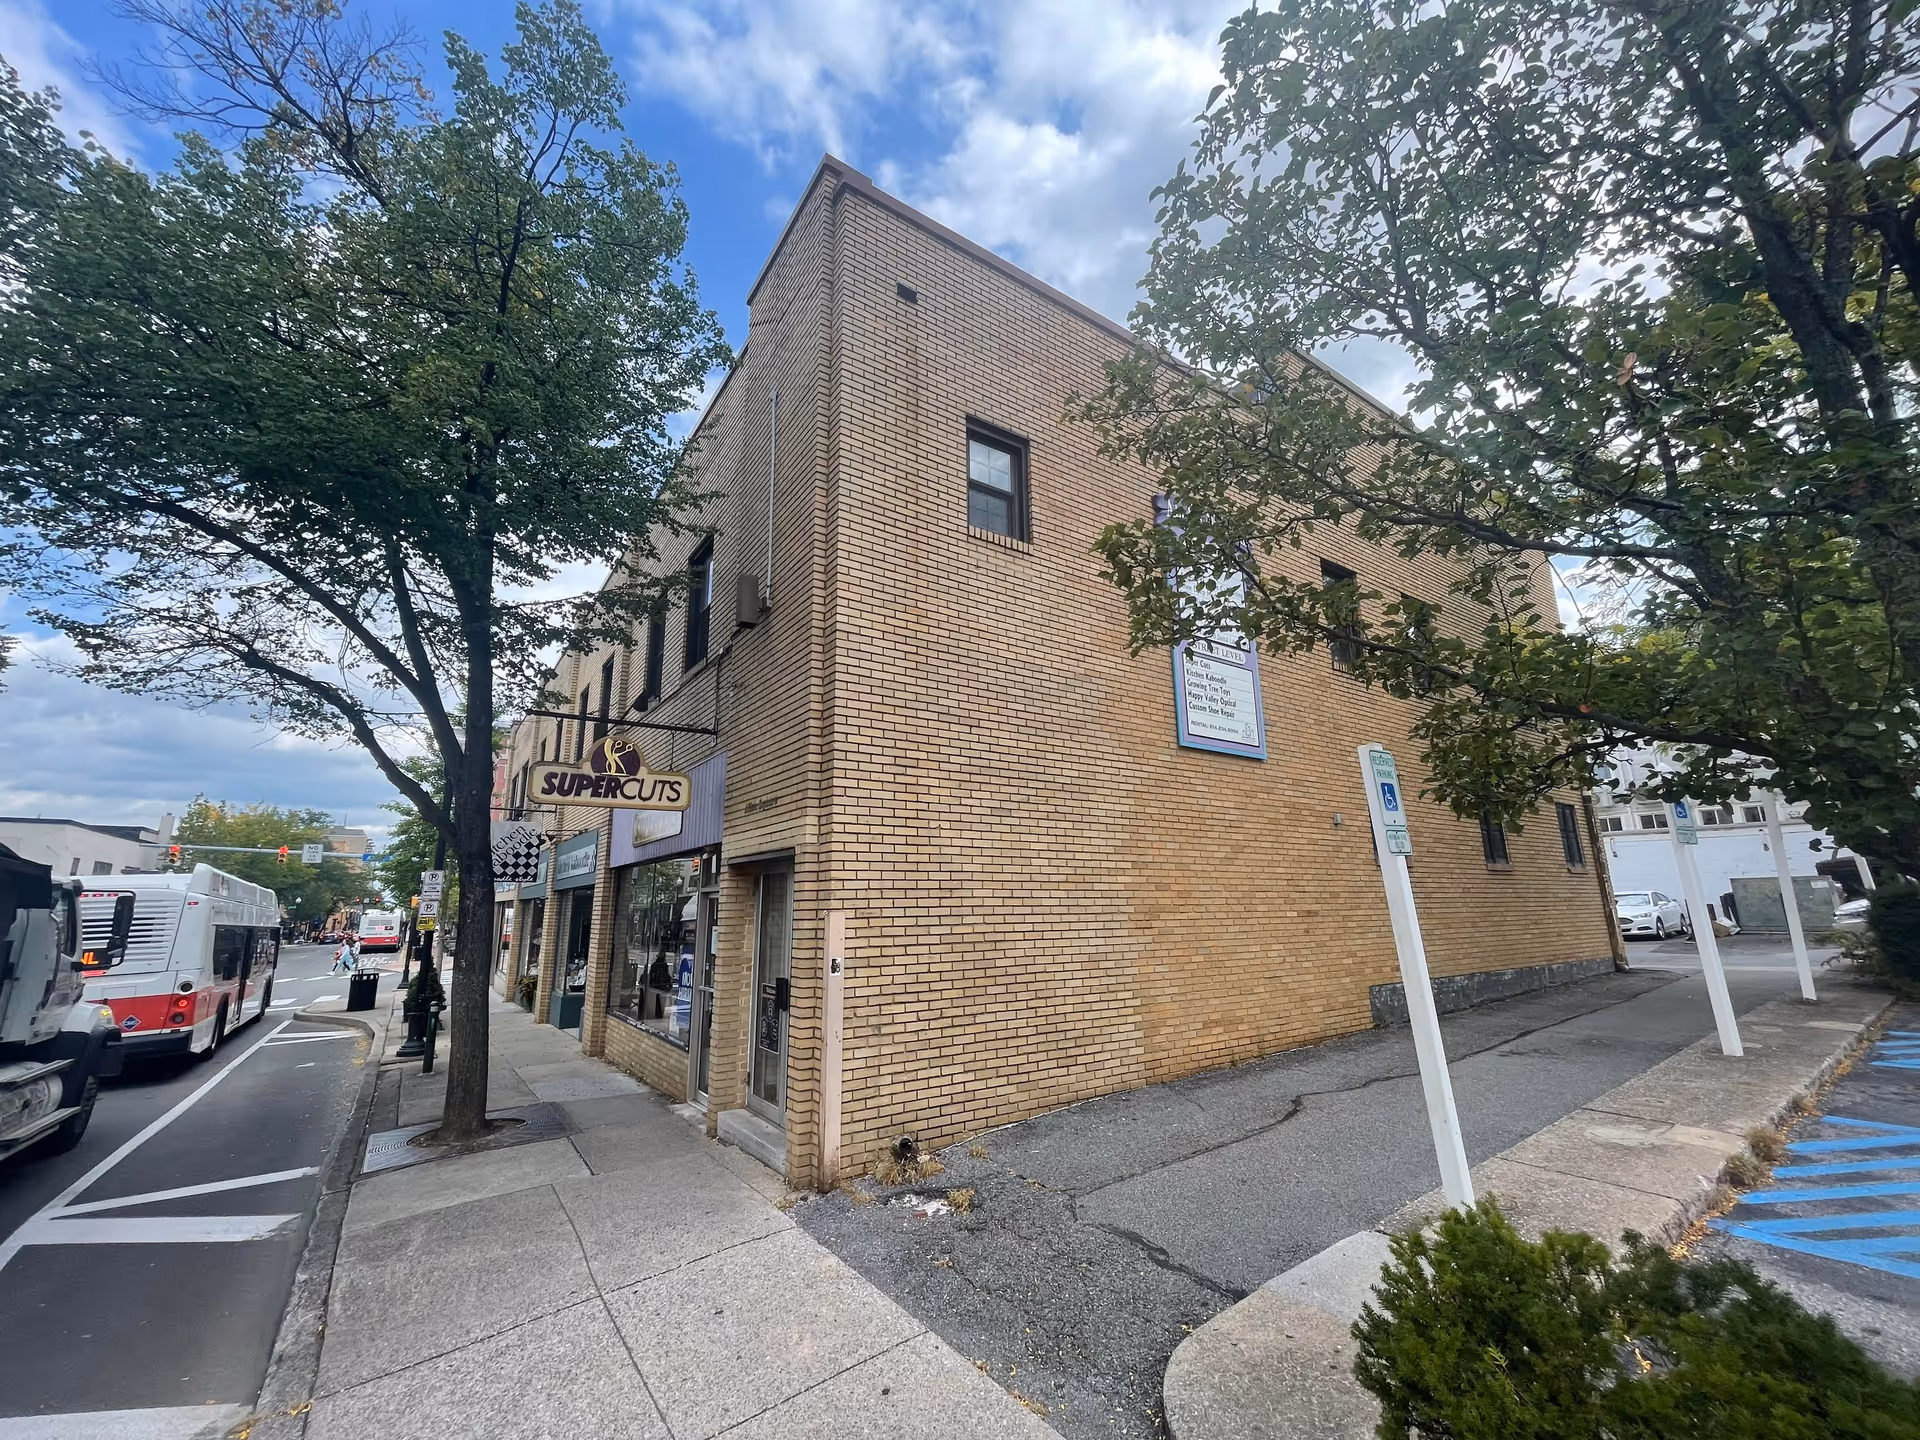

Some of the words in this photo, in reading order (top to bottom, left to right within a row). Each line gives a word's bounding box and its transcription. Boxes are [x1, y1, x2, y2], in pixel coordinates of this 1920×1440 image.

[1193, 641, 1220, 655] STRET
[1222, 649, 1244, 662] LEVEL
[1200, 659, 1211, 670] Cuts
[1186, 668, 1204, 680] Kitchen
[1205, 673, 1227, 685] Kaboodle
[1187, 679, 1207, 692] Growing
[1208, 683, 1219, 694] Tree
[1219, 687, 1231, 697] Toys
[1188, 690, 1203, 702] Happy
[1204, 694, 1219, 705] Valley
[1220, 697, 1237, 708] Optical
[1188, 701, 1207, 713] Custom
[1208, 705, 1219, 716] Shoe
[1220, 708, 1235, 718] Repair
[541, 771, 683, 802] SUPERCUTS
[490, 825, 526, 856] itchen
[492, 828, 538, 869] aboodle
